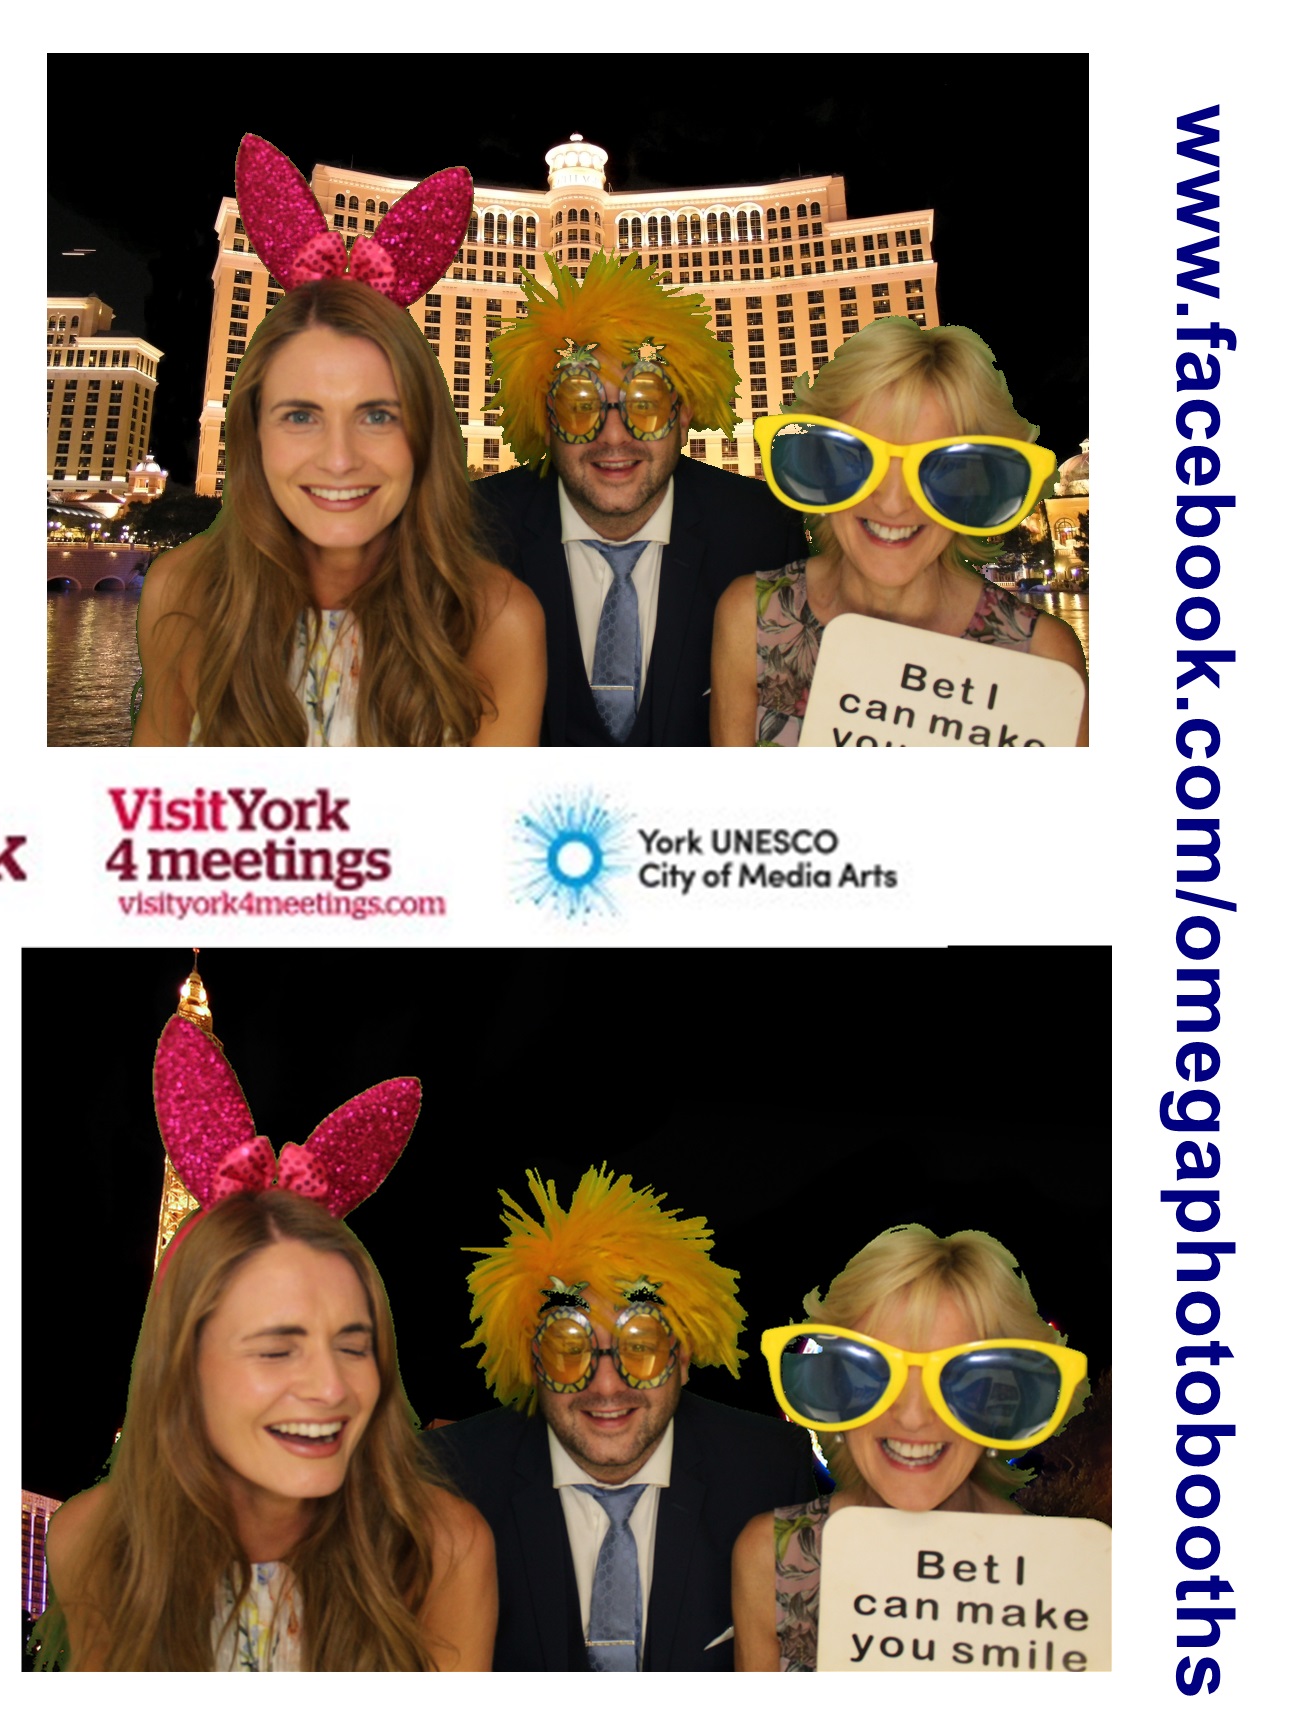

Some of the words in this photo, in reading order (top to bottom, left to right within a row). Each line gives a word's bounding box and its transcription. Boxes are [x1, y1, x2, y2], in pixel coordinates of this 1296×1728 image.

[901, 663, 974, 705] Bet
[988, 683, 998, 710] I
[839, 693, 915, 728] can
[917, 1550, 1000, 1584] Bet
[1016, 1556, 1025, 1586] I
[853, 1594, 939, 1621] can
[957, 1598, 1089, 1632] make
[850, 1633, 936, 1663] you
[952, 1640, 1088, 1672] smile
